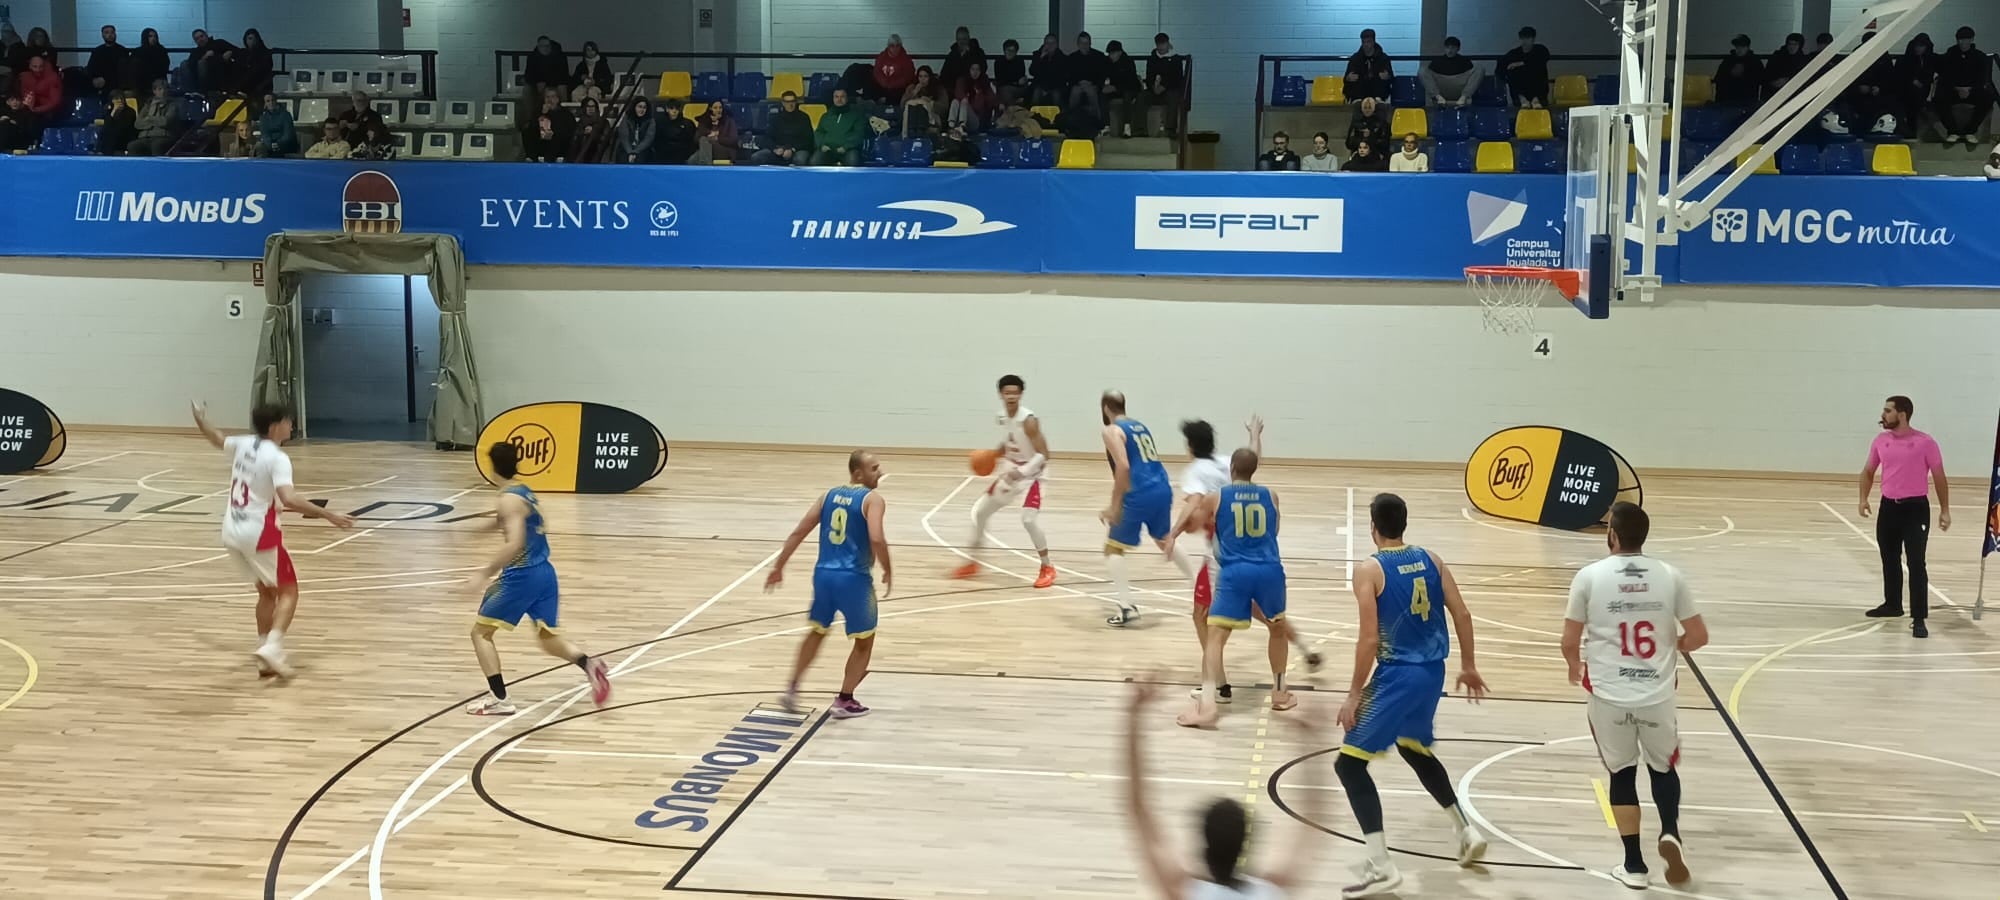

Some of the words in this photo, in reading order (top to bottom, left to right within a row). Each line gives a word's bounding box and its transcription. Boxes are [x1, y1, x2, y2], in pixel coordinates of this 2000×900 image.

[480, 198, 629, 230] EVENTS
[791, 219, 923, 240] TRANSVISA
[1756, 208, 1853, 244] MGC
[1506, 238, 1549, 249] Campus
[229, 300, 241, 317] 5
[1534, 338, 1550, 356] 4
[0, 415, 24, 426] IVE
[596, 432, 630, 443] LIVE
[0, 441, 22, 452] OW
[595, 445, 640, 457] MORE
[594, 458, 630, 469] NOW
[1567, 463, 1596, 477] LIVE
[1493, 457, 1530, 490] Buff
[1563, 477, 1601, 493] MORE
[1559, 490, 1589, 506] NOW
[828, 507, 848, 545] 9
[1230, 502, 1267, 538] 10
[1410, 576, 1430, 622] 4
[1619, 620, 1657, 660] 16
